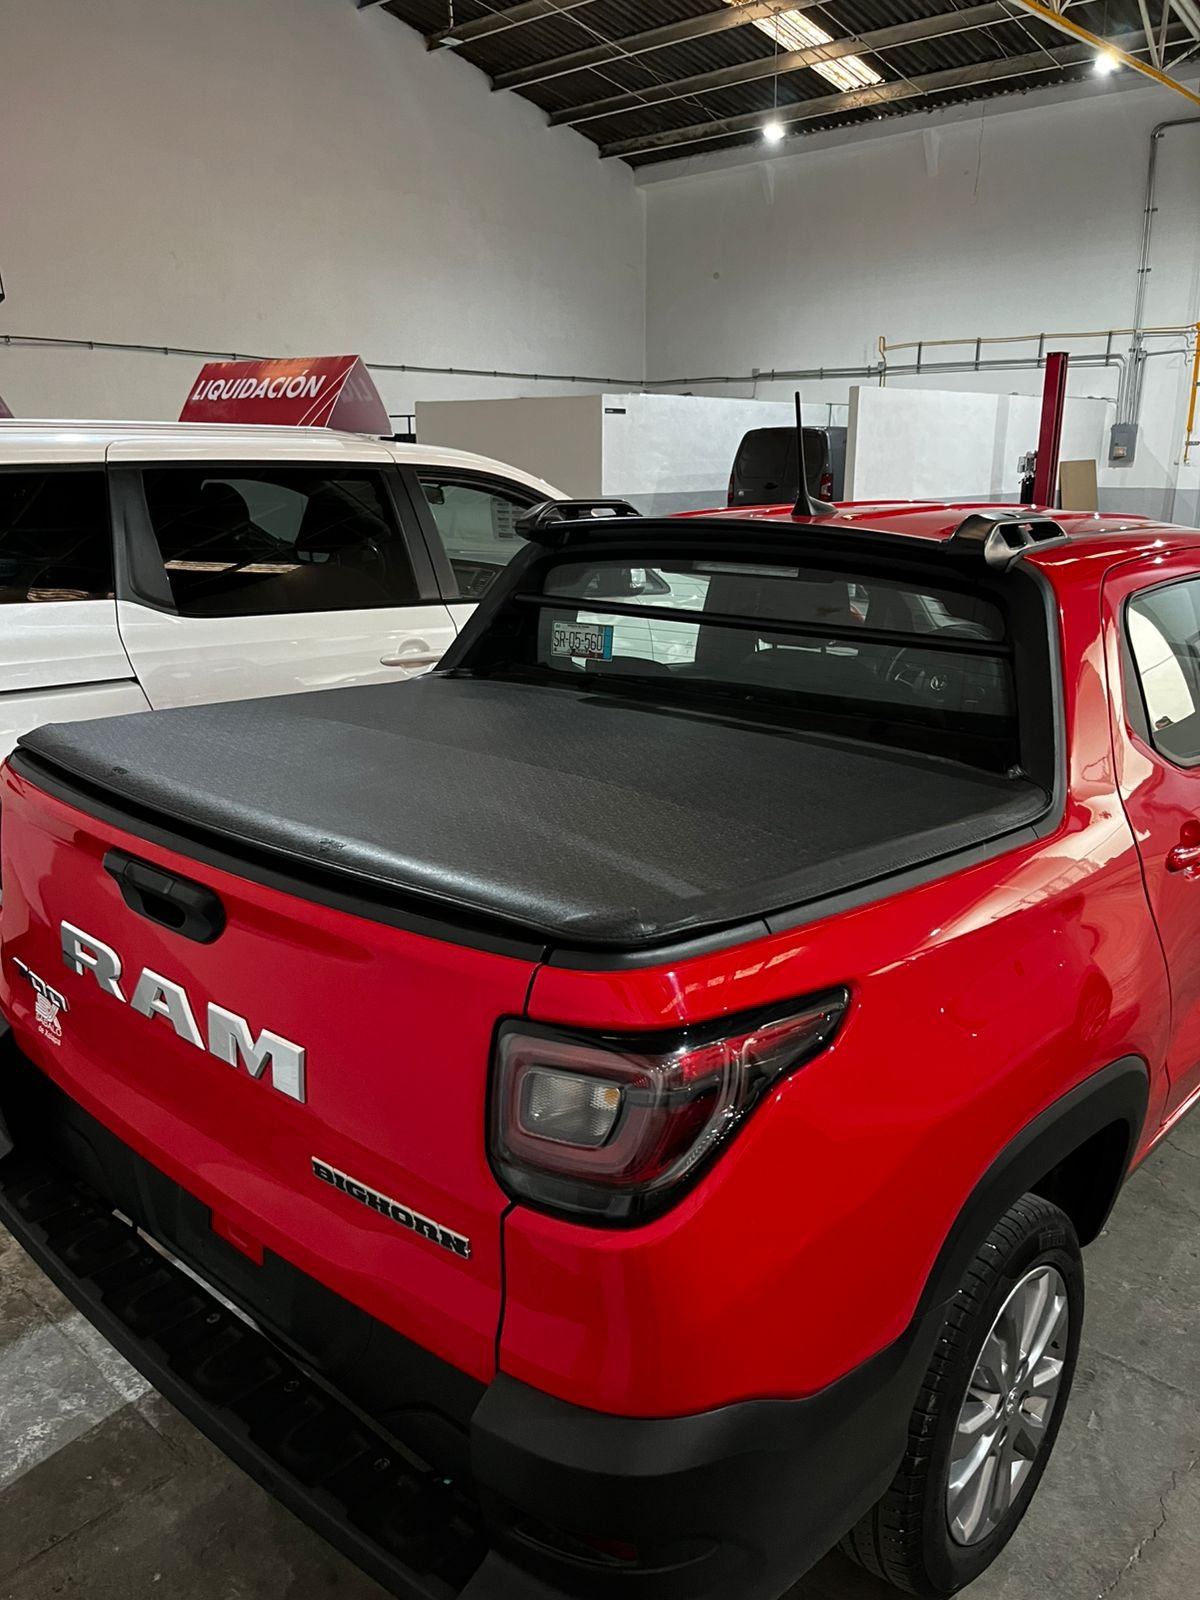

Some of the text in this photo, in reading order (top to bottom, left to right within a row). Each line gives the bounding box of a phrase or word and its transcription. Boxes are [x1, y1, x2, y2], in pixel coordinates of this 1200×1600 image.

[192, 369, 326, 400] LIQUIDACIÓN
[553, 630, 603, 651] SR-05-560
[61, 919, 306, 1104] RAM
[311, 1155, 471, 1259] BIGHORN
